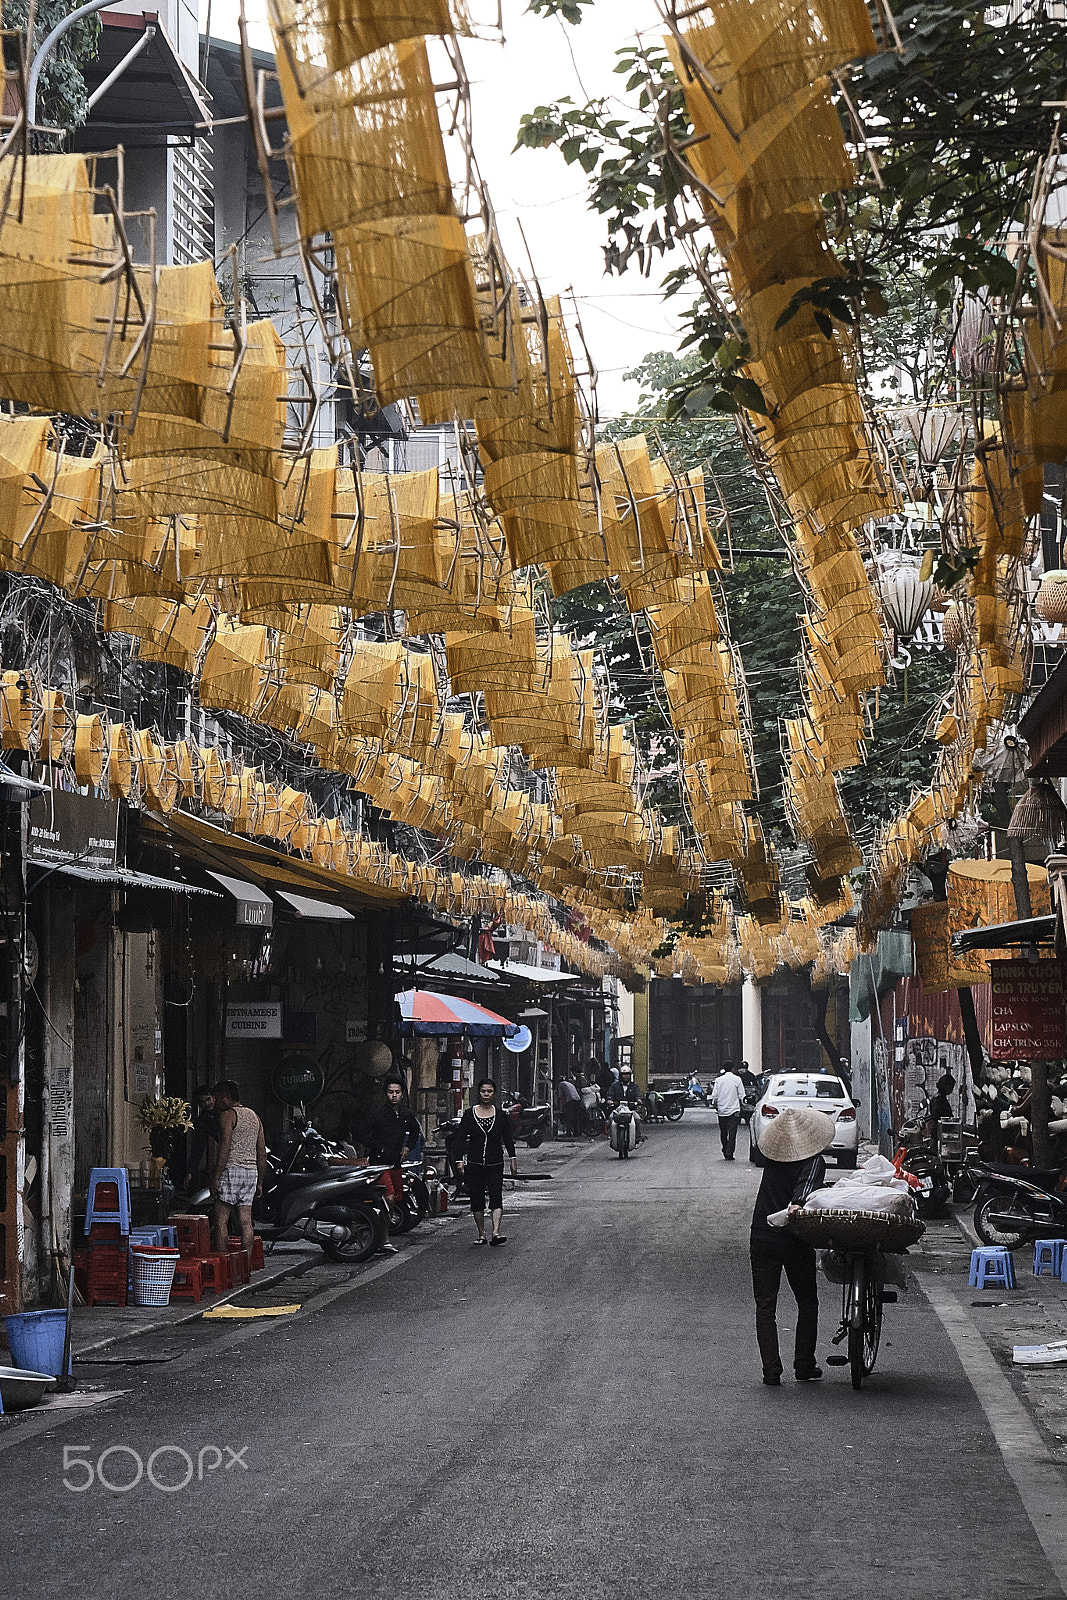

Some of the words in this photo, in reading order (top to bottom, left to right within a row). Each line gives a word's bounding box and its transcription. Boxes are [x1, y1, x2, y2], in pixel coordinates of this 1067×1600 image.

[225, 1008, 278, 1017] IETNAMESE
[231, 1021, 267, 1030] CUISINE
[281, 1072, 315, 1084] TUBORG
